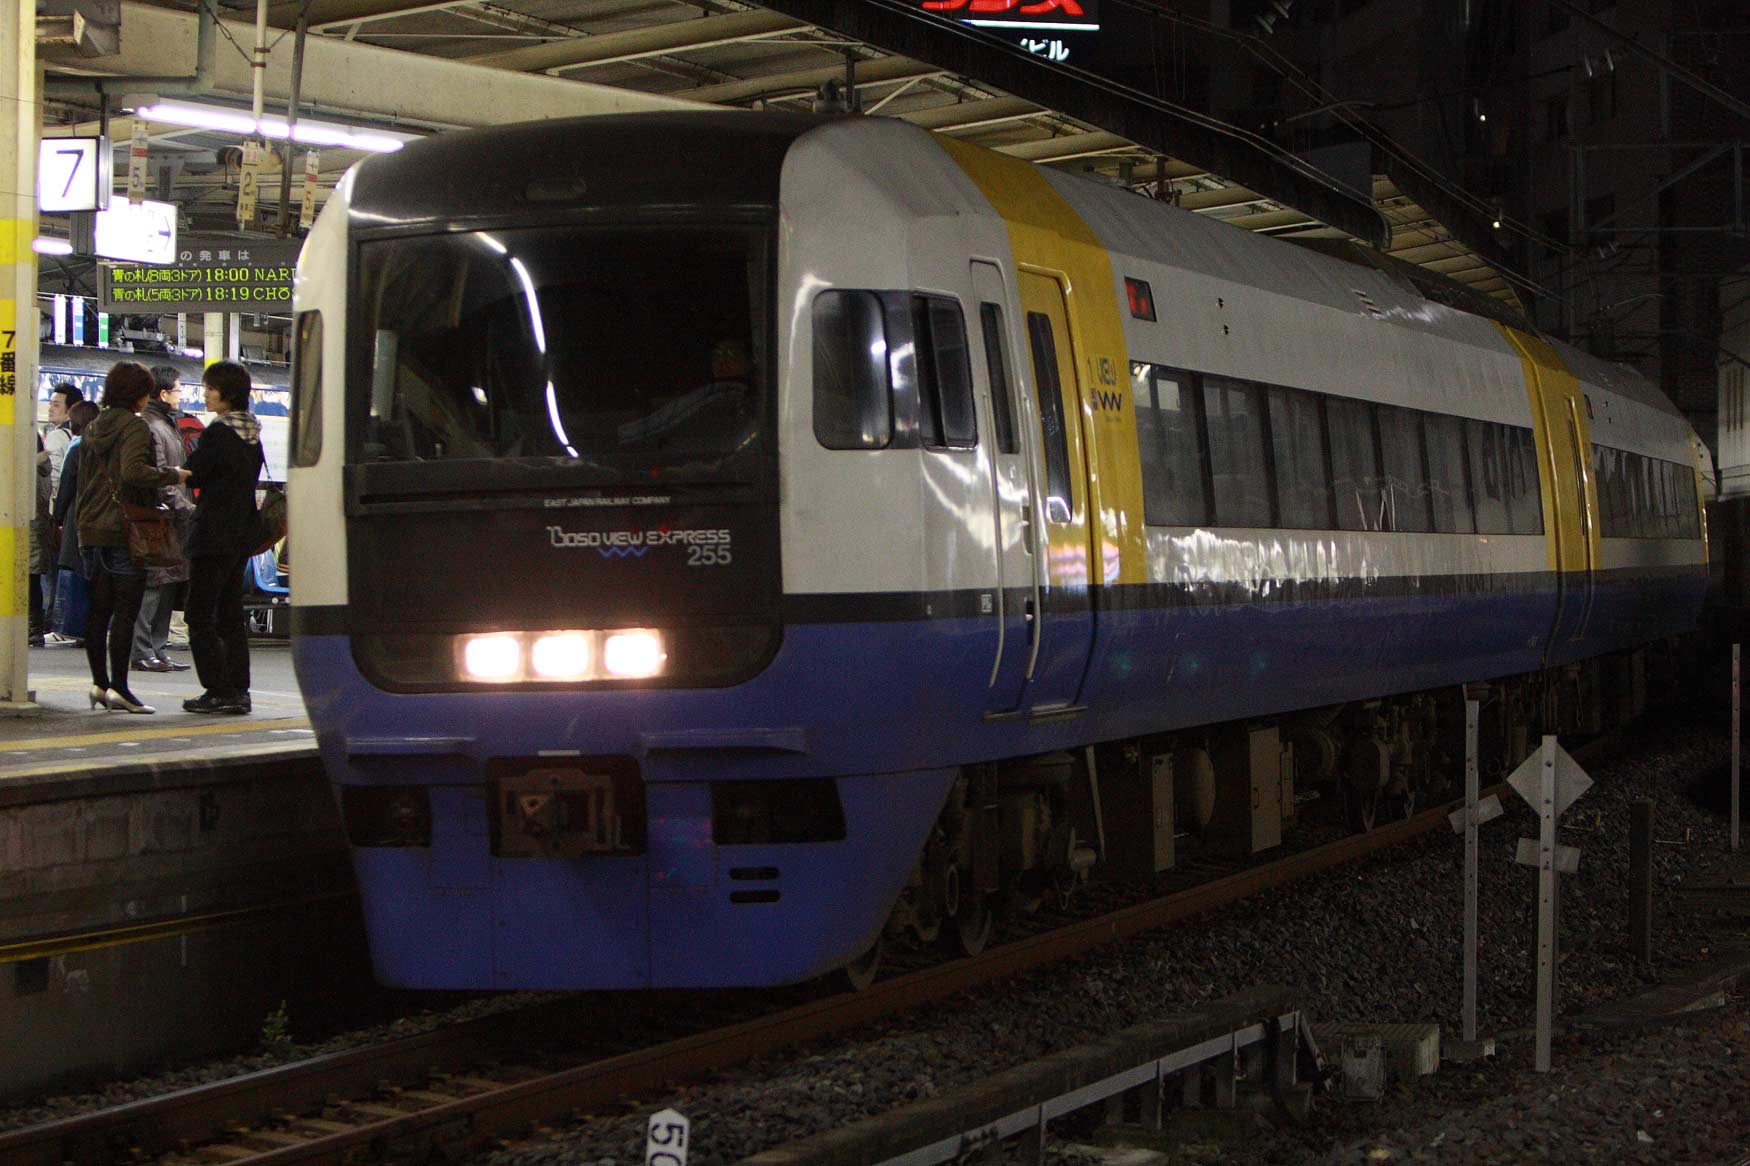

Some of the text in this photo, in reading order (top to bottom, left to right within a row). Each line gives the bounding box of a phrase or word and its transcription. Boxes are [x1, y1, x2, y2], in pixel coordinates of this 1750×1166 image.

[56, 148, 84, 198] 7
[132, 166, 141, 188] 5
[242, 170, 253, 196] 2
[206, 268, 249, 282] 18:00
[206, 287, 249, 301] 18:19
[603, 531, 643, 546] VIEW
[646, 530, 731, 545] EXPRESS
[687, 546, 732, 566] 255
